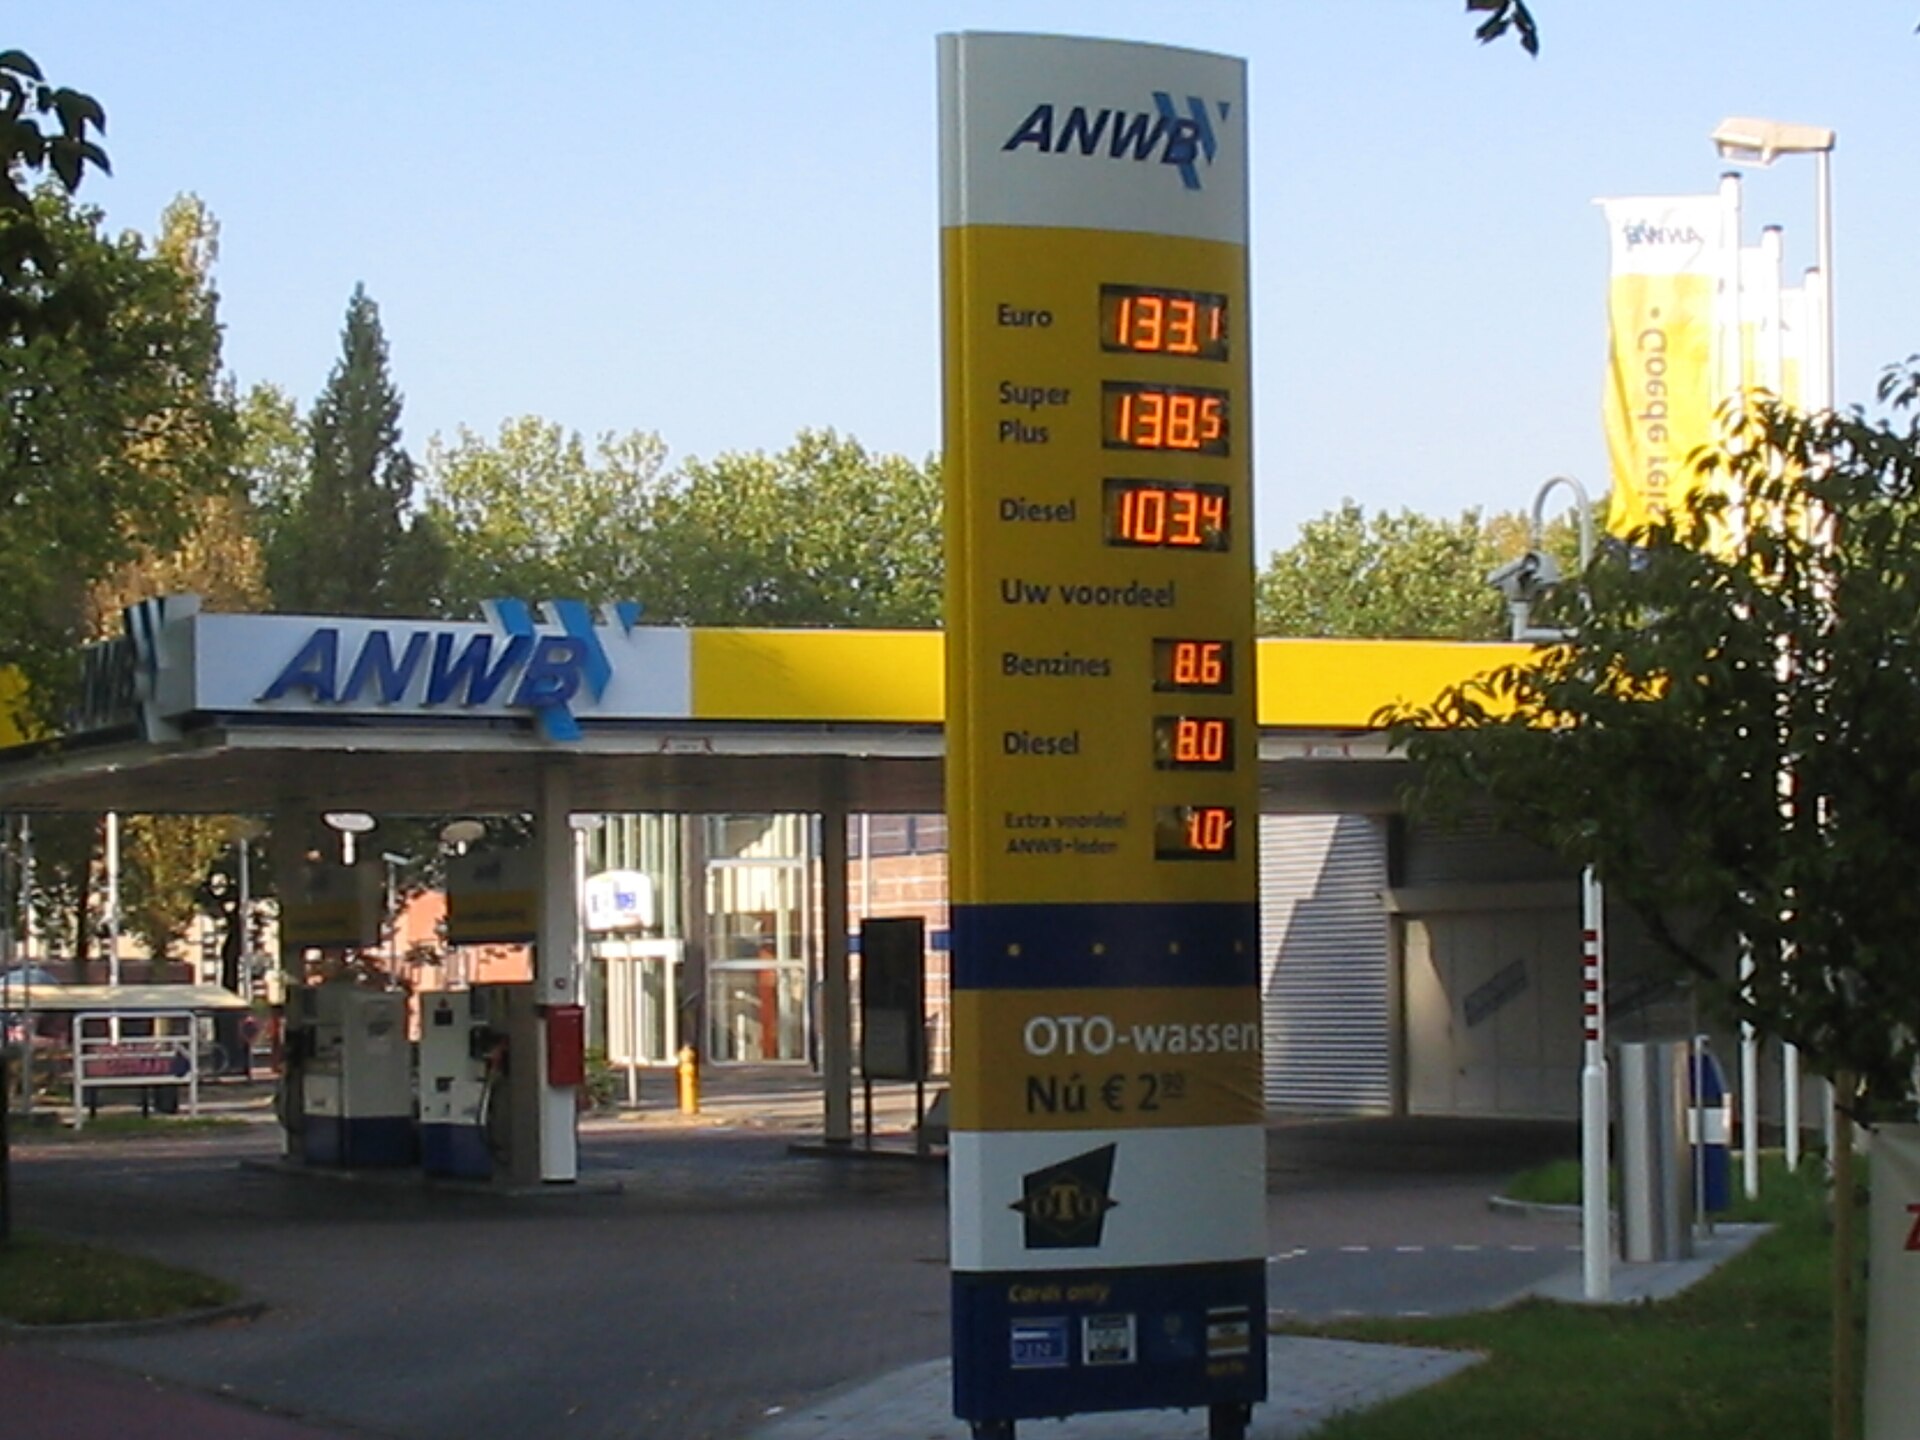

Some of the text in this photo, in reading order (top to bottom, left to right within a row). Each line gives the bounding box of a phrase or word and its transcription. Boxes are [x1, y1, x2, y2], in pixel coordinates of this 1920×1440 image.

[1001, 103, 1199, 165] ANWB
[998, 304, 1053, 328] Euro
[999, 381, 1071, 411] Super
[1000, 419, 1048, 444] Plus
[1000, 497, 1077, 522] Diesel
[1002, 578, 1175, 607] Uw voordeel
[254, 627, 590, 709] ANWB
[1002, 652, 1111, 677] Benzines
[1003, 731, 1079, 755] Diesel
[1023, 1015, 1259, 1056] OTO-wassen
[1025, 1073, 1086, 1114] Nú
[1101, 1074, 1126, 1112] €
